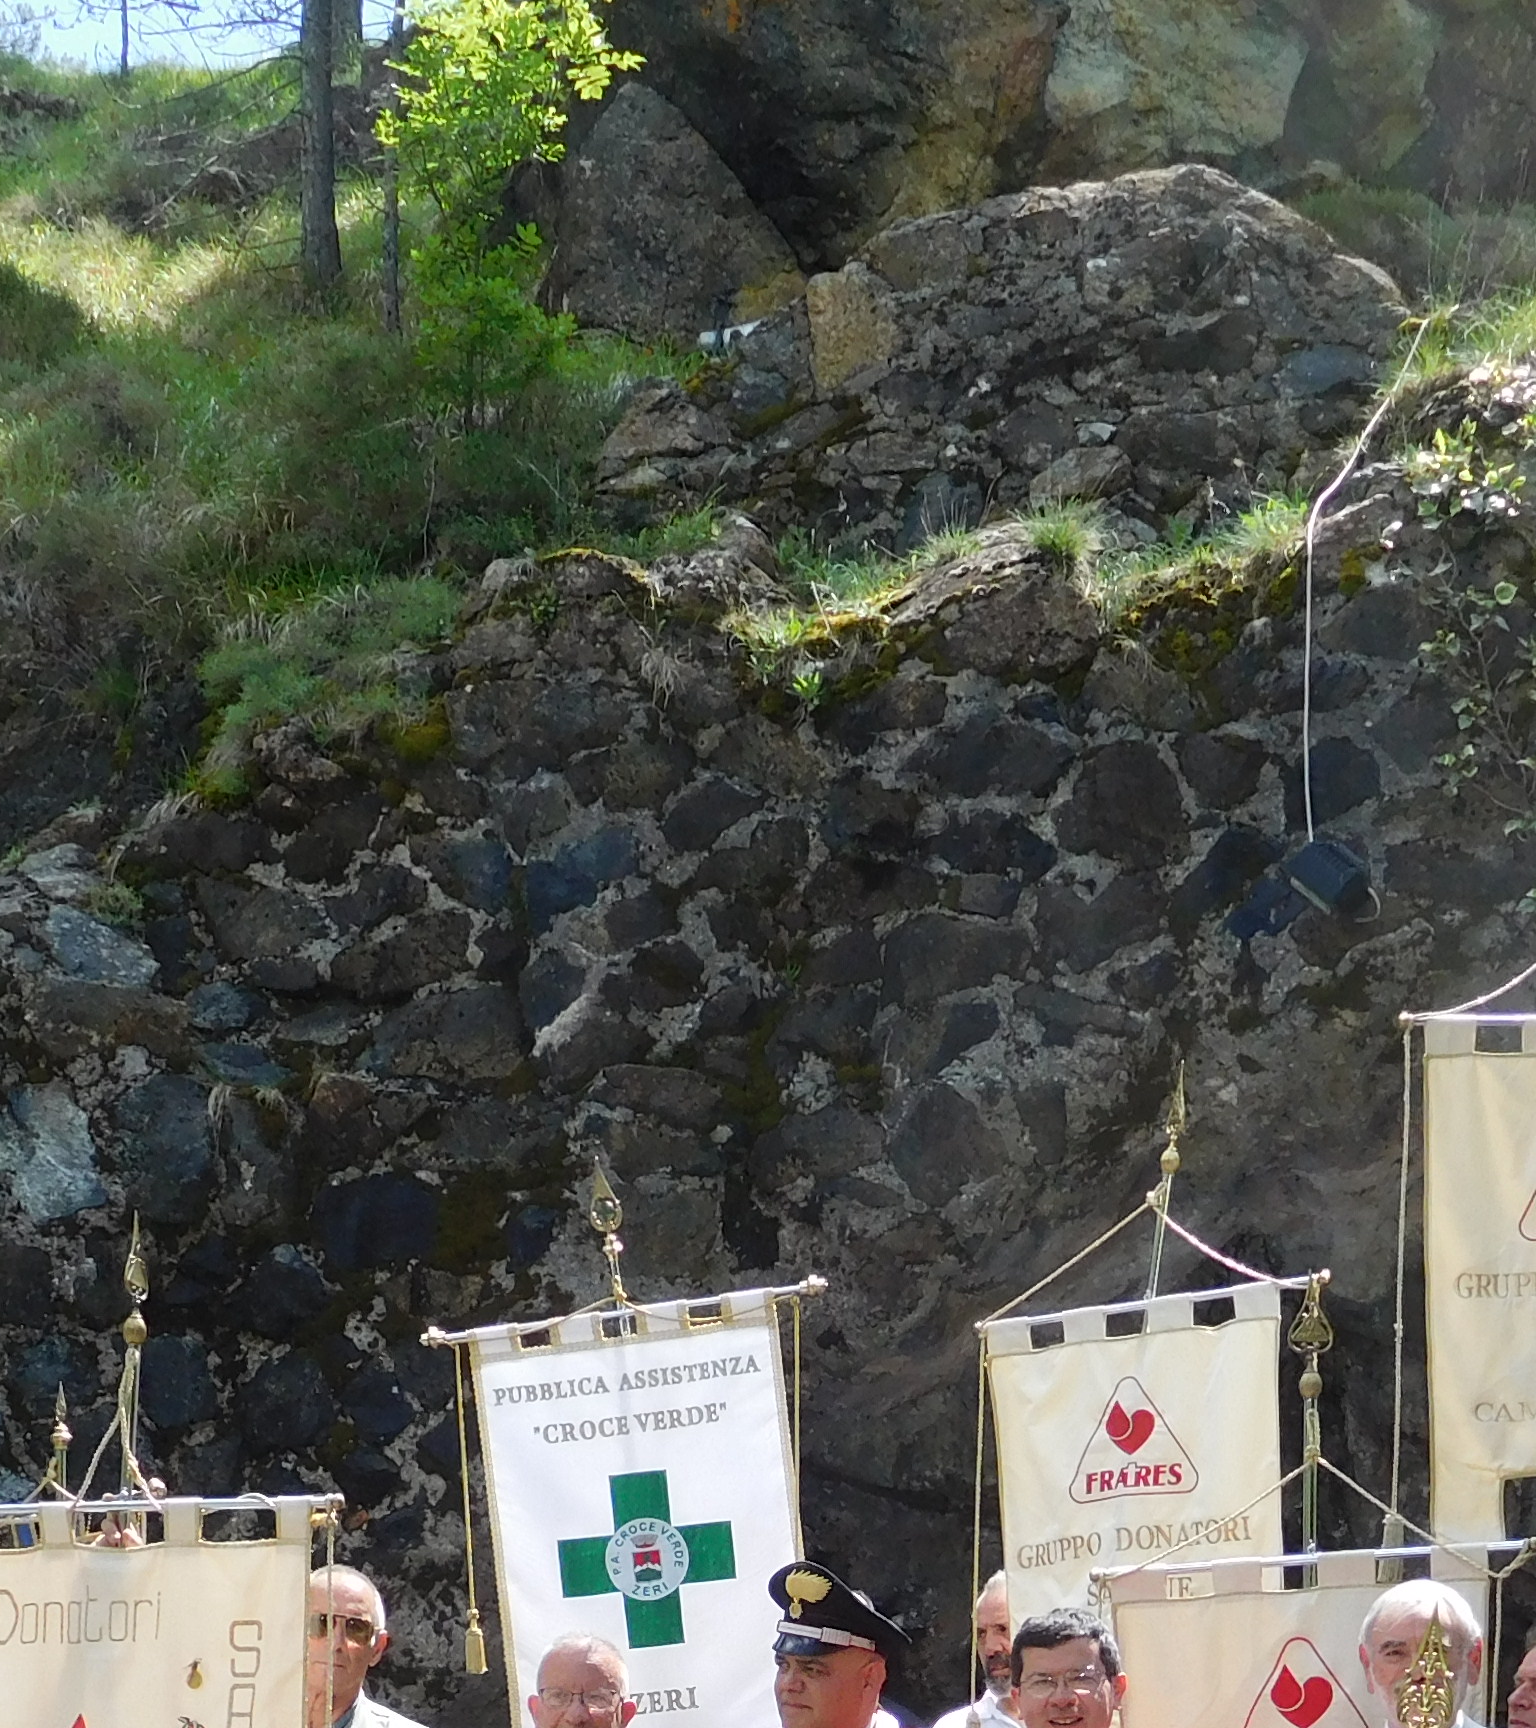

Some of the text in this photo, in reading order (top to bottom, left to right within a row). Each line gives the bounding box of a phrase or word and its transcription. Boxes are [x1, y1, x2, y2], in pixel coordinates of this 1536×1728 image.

[492, 1355, 761, 1406] PUBBLICA ASSISTENZA
[533, 1401, 727, 1444] "CROCE VERDE"
[1085, 1461, 1183, 1494] FRATRES
[615, 1521, 656, 1548] CROCE
[661, 1526, 684, 1568] VERDE
[1016, 1516, 1252, 1569] GRUPPO DONATORI
[632, 1581, 668, 1597] ZERI
[629, 1686, 700, 1715] ZERI
